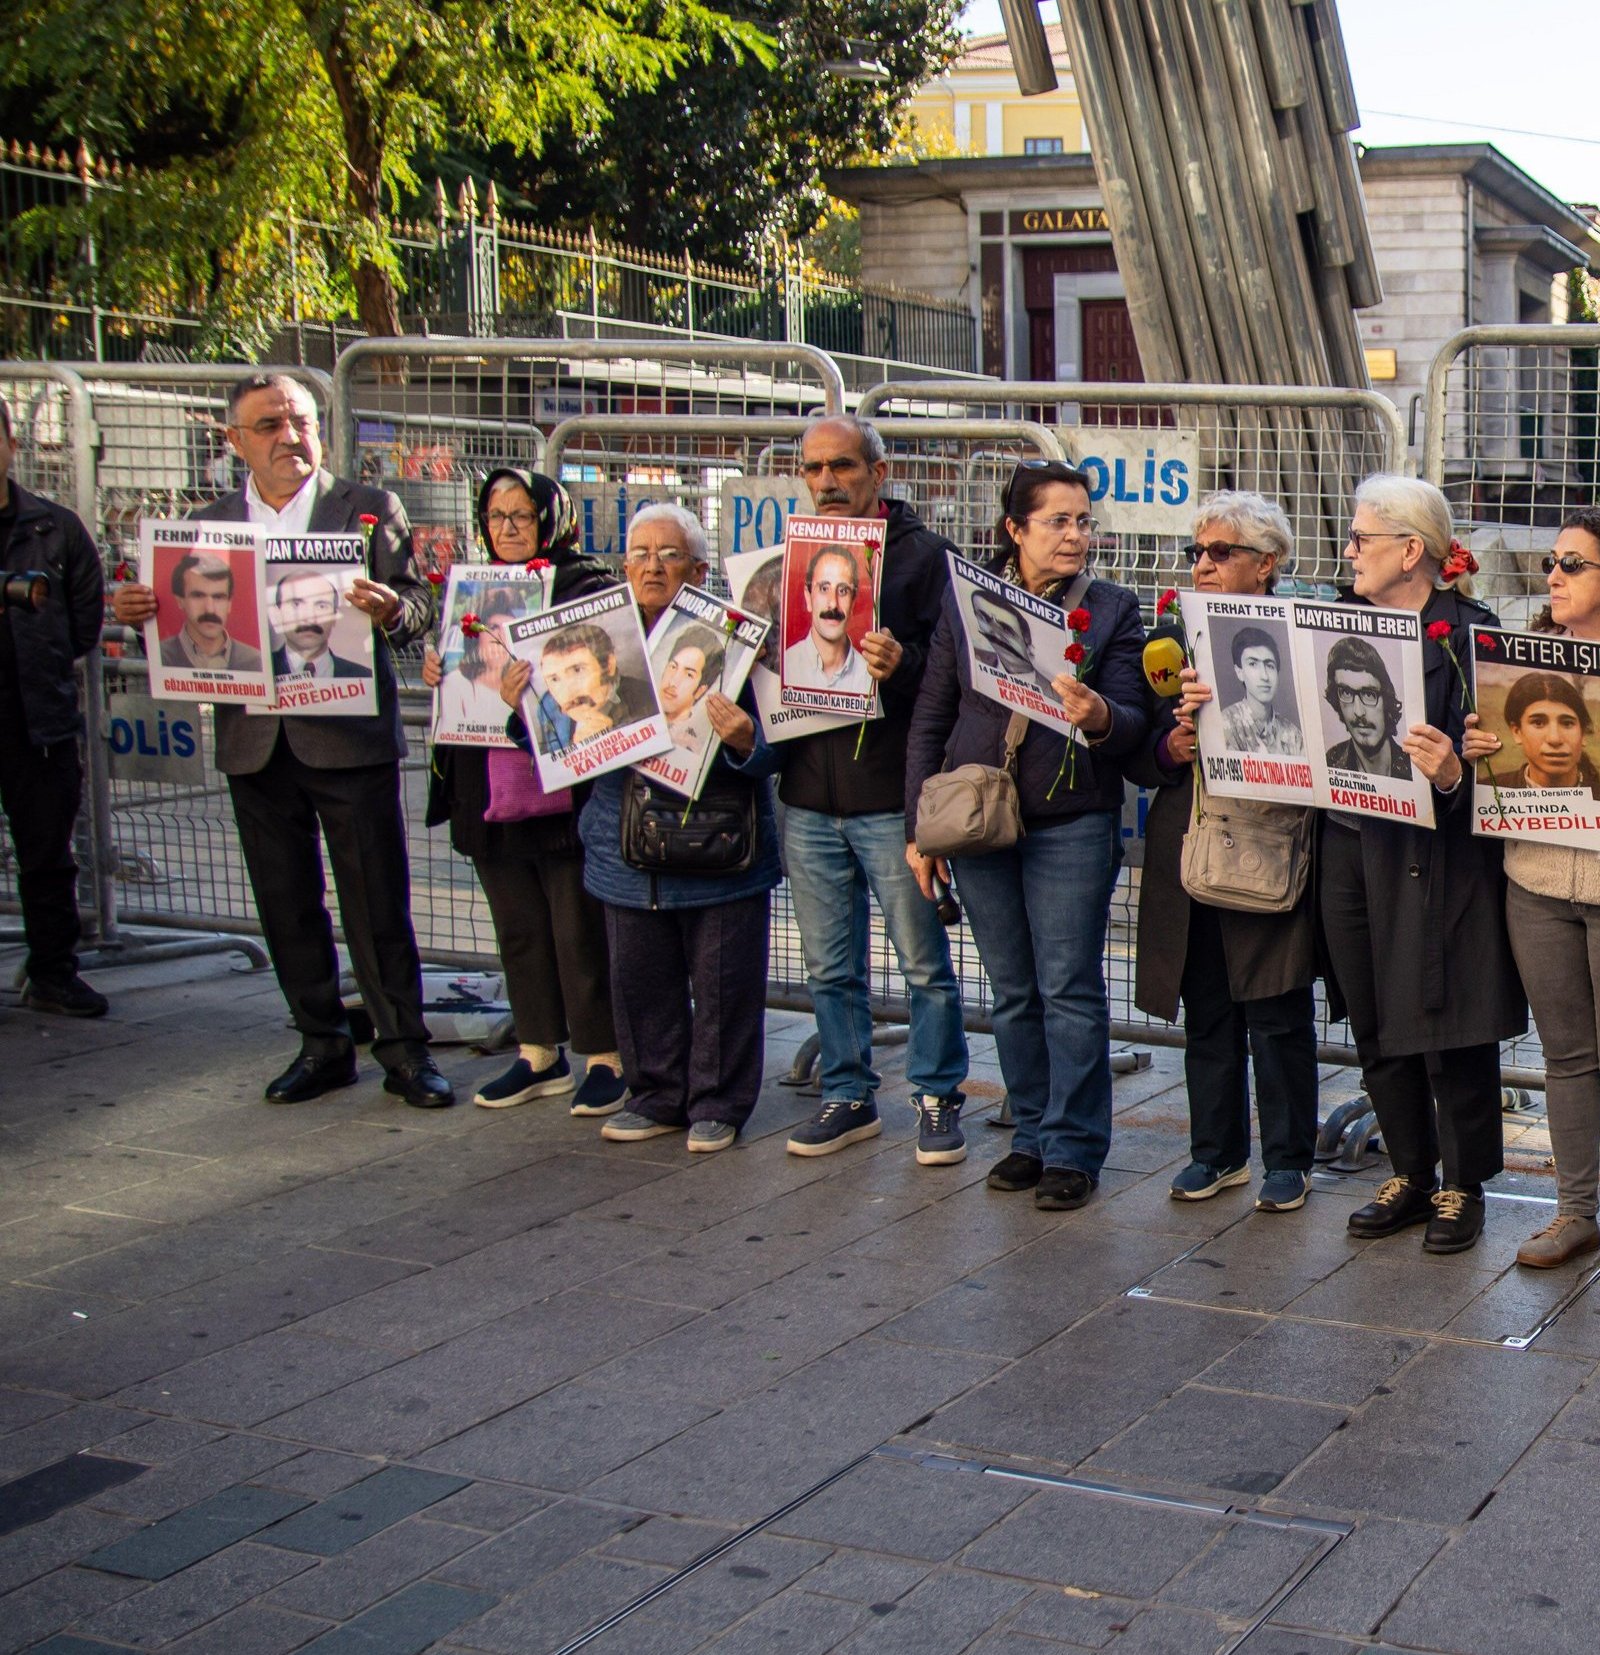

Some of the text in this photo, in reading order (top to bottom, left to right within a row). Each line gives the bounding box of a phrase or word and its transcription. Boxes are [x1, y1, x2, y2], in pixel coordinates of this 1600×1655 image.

[1023, 209, 1109, 232] GALATA
[153, 528, 255, 546] FEHMİ TOSUN
[788, 521, 883, 542] KENAN BİLGİN
[295, 541, 363, 566] KARAKOÇ
[957, 561, 1063, 625] NAZIM GÜLMEZ
[560, 592, 626, 624] KIRBAYIR
[675, 590, 764, 645] MURAT YDIZ
[1206, 602, 1286, 618] FERHAT TEPE
[1295, 608, 1418, 638] HAYRETTİN EREN
[1500, 635, 1566, 667] YETER
[978, 664, 989, 673] 14
[164, 678, 266, 697] GÖZALTINDA KAYBEDİLDİ
[782, 689, 829, 706] GÖZALTINDA
[996, 678, 1045, 702] GÖZALTINDA
[440, 733, 487, 743] GÖZALTINDA
[466, 723, 487, 733] KASIM
[563, 731, 626, 769] GÖZALTINDA
[573, 723, 657, 777] KAYBEDİLDİ
[1206, 756, 1244, 783] 28-07-1993
[1242, 755, 1285, 786] GÖZALTINDA
[1328, 776, 1377, 793] GÖZALTINDA
[1495, 788, 1584, 800] 4.09.1994, Dersim'de
[1330, 788, 1417, 818] KAYBEDİLDİ
[1477, 803, 1570, 816] GÖZALTINDA
